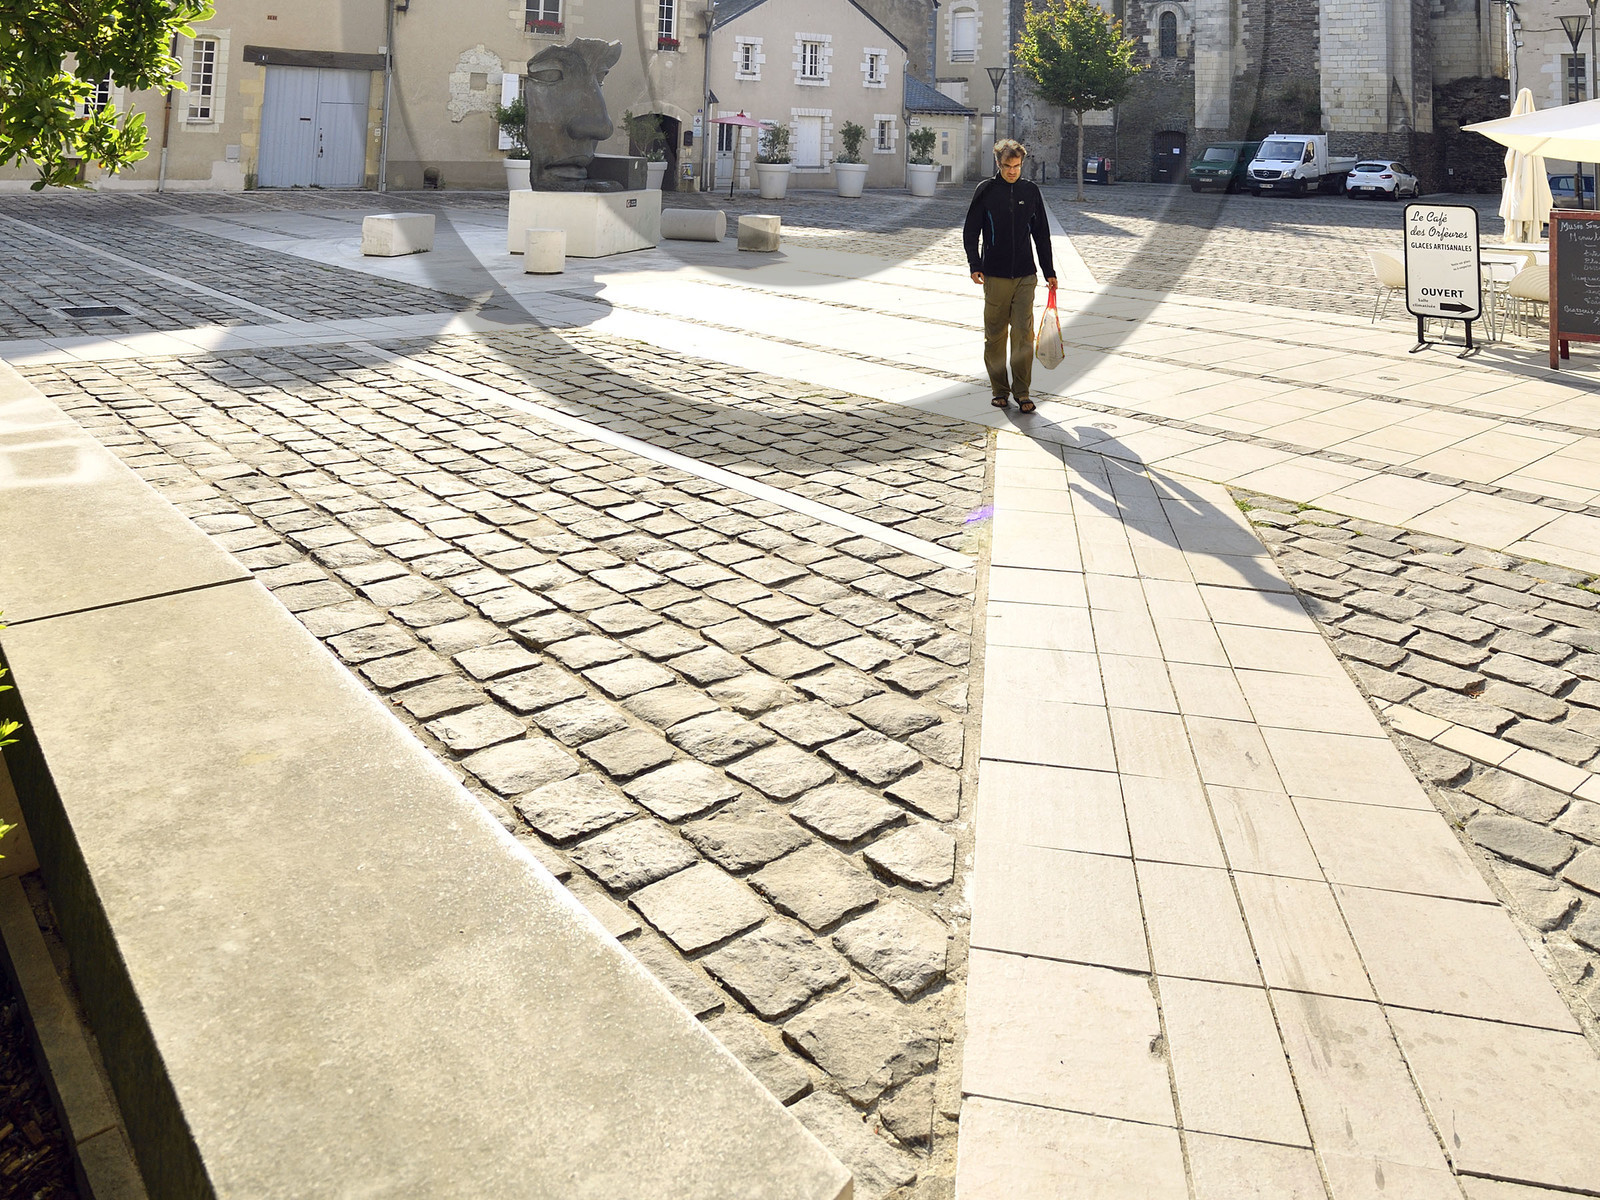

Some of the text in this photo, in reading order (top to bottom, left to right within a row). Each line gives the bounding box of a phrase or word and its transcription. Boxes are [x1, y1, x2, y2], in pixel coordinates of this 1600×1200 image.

[1411, 211, 1448, 226] Le Café
[1410, 225, 1468, 241] des Orfèvres
[1434, 243, 1472, 252] ARTISANALES
[1421, 288, 1464, 298] OUVERT
